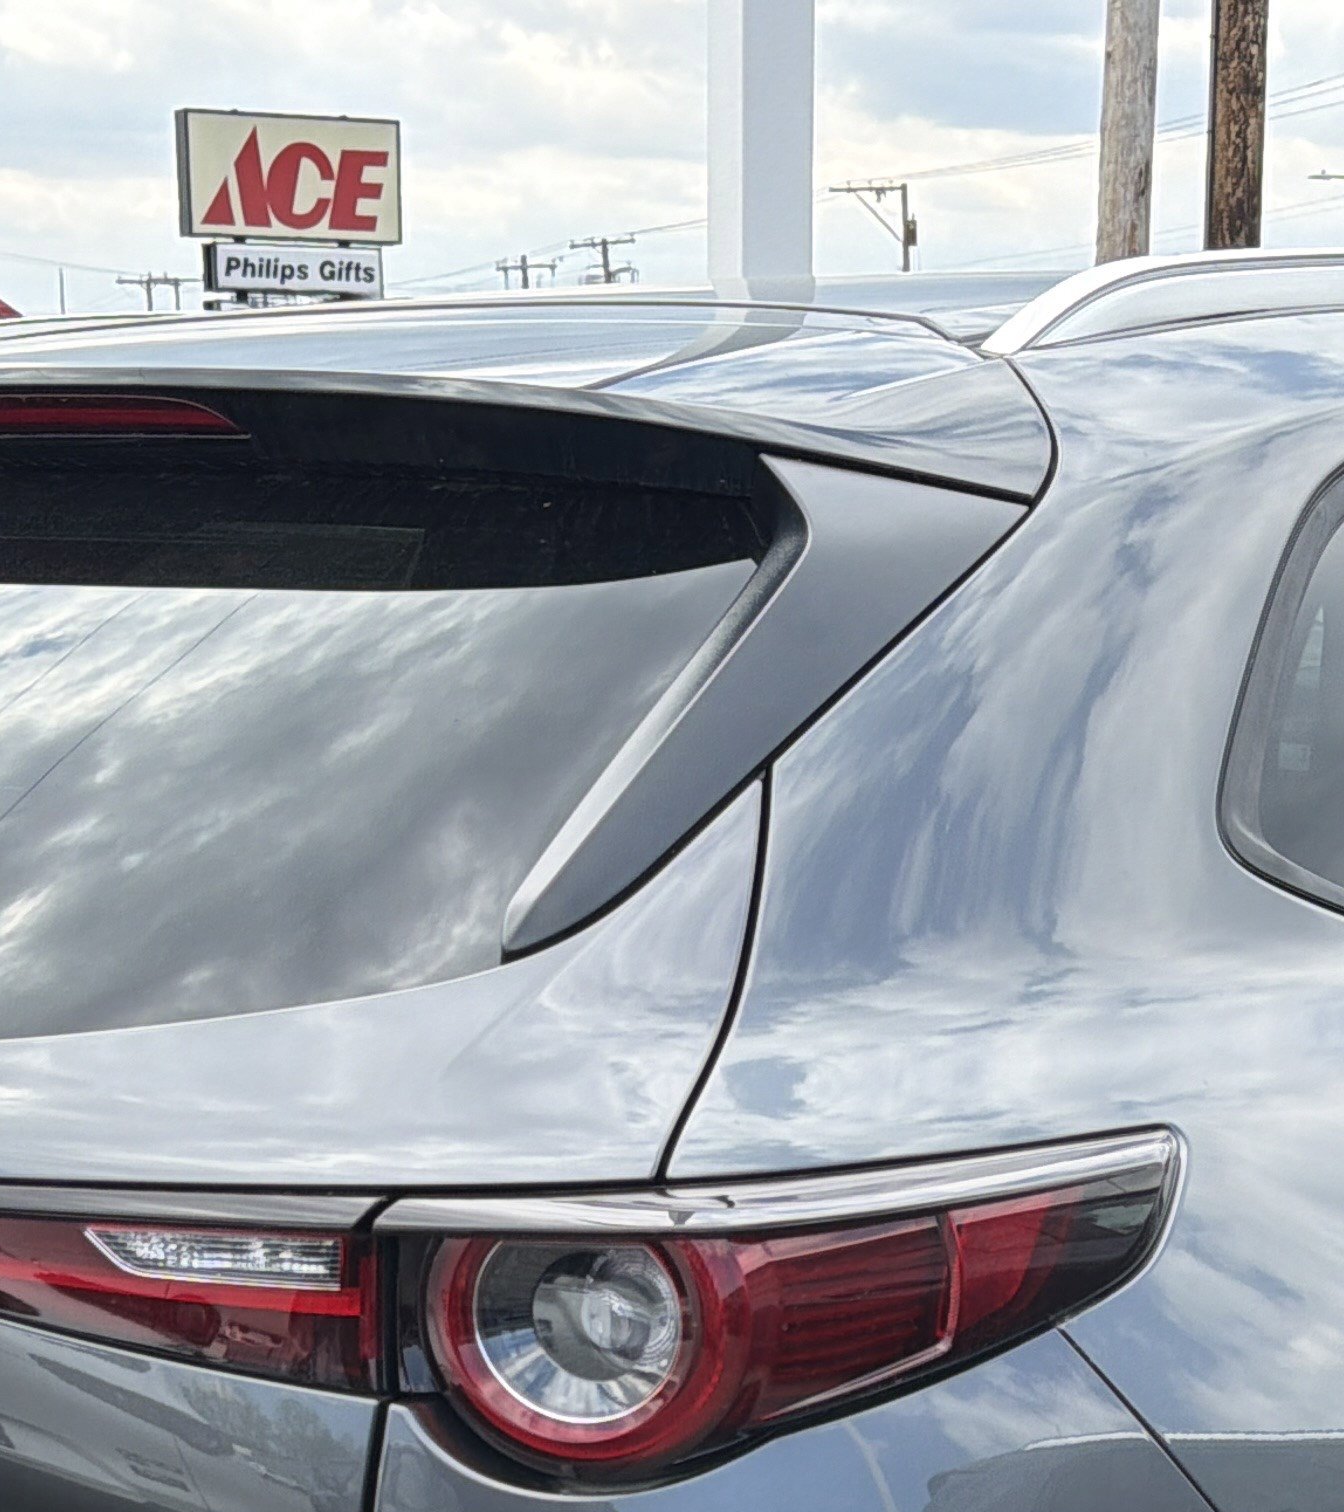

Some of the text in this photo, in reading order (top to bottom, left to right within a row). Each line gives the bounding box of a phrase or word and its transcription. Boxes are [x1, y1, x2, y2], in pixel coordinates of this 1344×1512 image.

[201, 125, 389, 232] ACE
[224, 256, 376, 285] Philips Gifts
